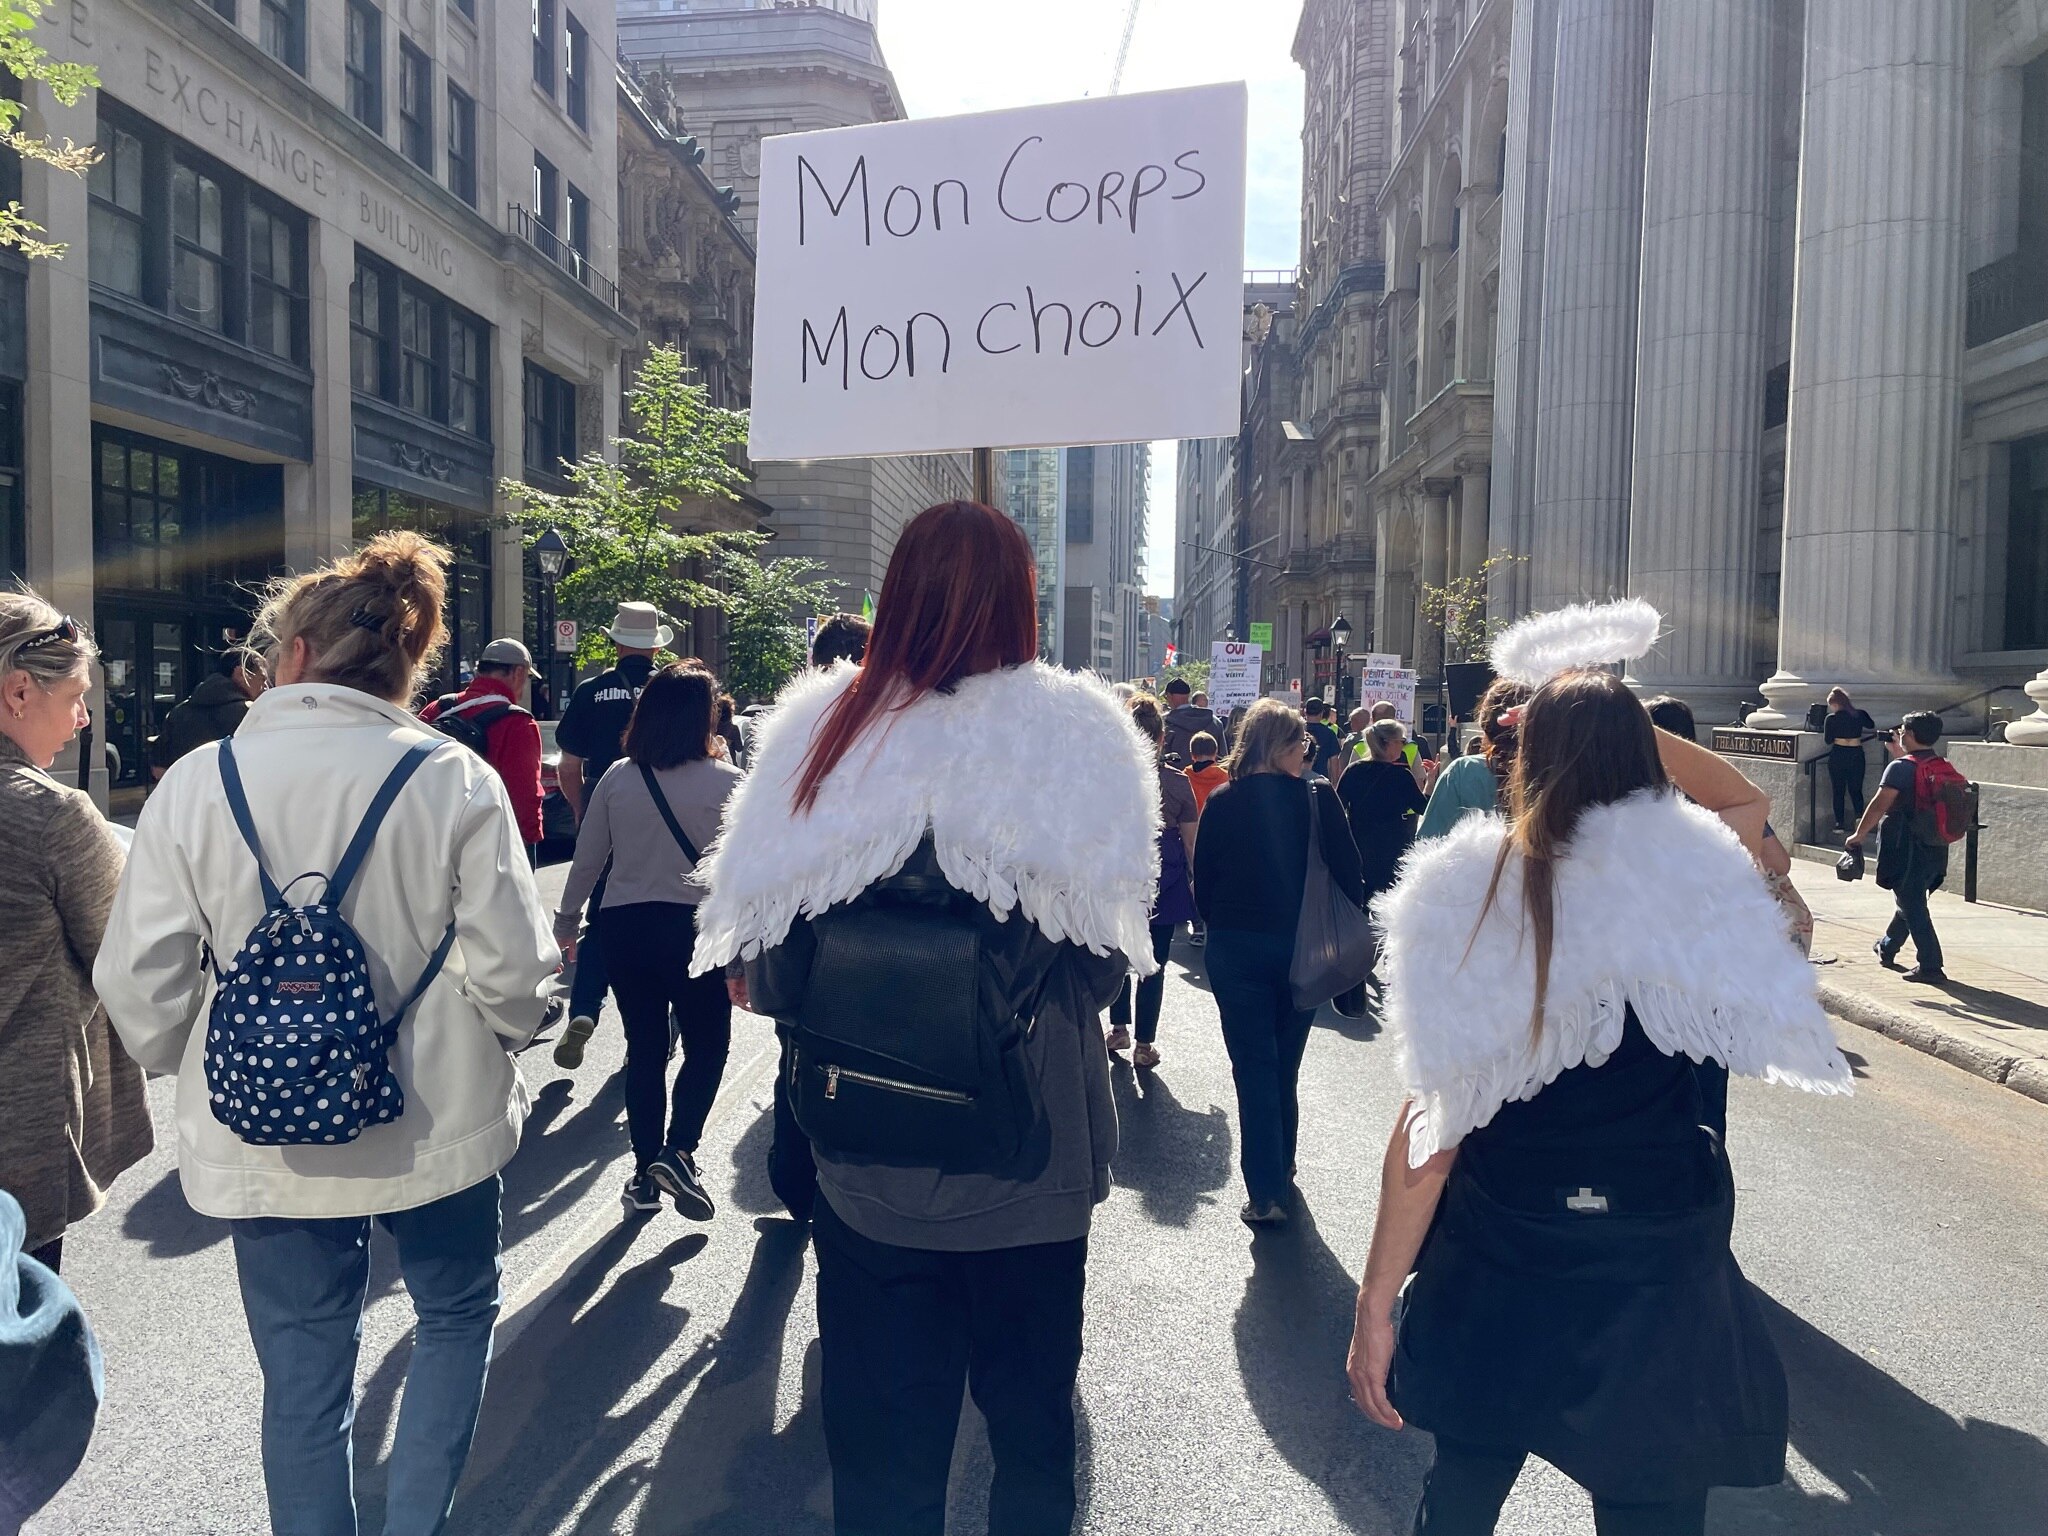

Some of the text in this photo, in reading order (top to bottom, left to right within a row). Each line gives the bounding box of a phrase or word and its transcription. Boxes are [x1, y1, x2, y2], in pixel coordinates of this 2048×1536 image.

[145, 46, 328, 197] EXCHANGE
[359, 190, 453, 277] BUILDING
[798, 154, 970, 247] Mon
[801, 305, 952, 391] Mon
[1225, 643, 1246, 655] OUI
[276, 981, 321, 994] JANSPORT
